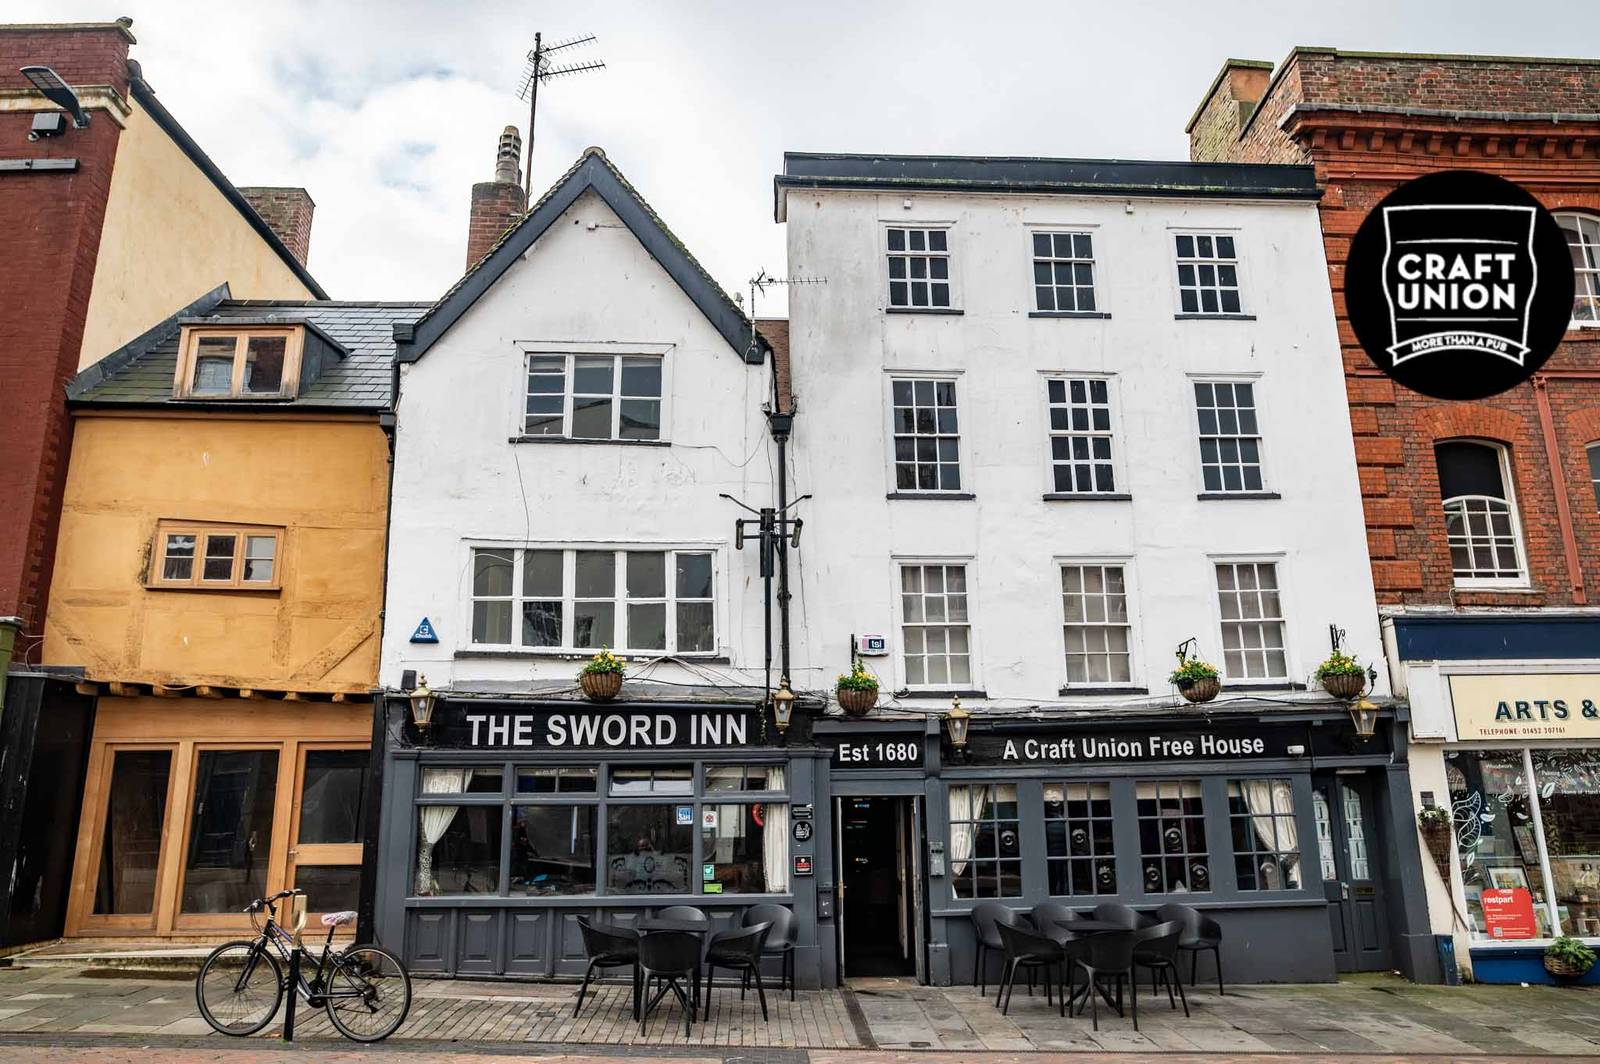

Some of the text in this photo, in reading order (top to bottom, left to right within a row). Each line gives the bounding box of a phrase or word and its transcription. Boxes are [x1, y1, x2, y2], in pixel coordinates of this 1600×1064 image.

[1495, 699, 1600, 720] ARTS &
[466, 714, 747, 746] THE SWORD INN
[839, 742, 918, 762] Est 1680
[1003, 735, 1265, 760] A Craft Union Free House
